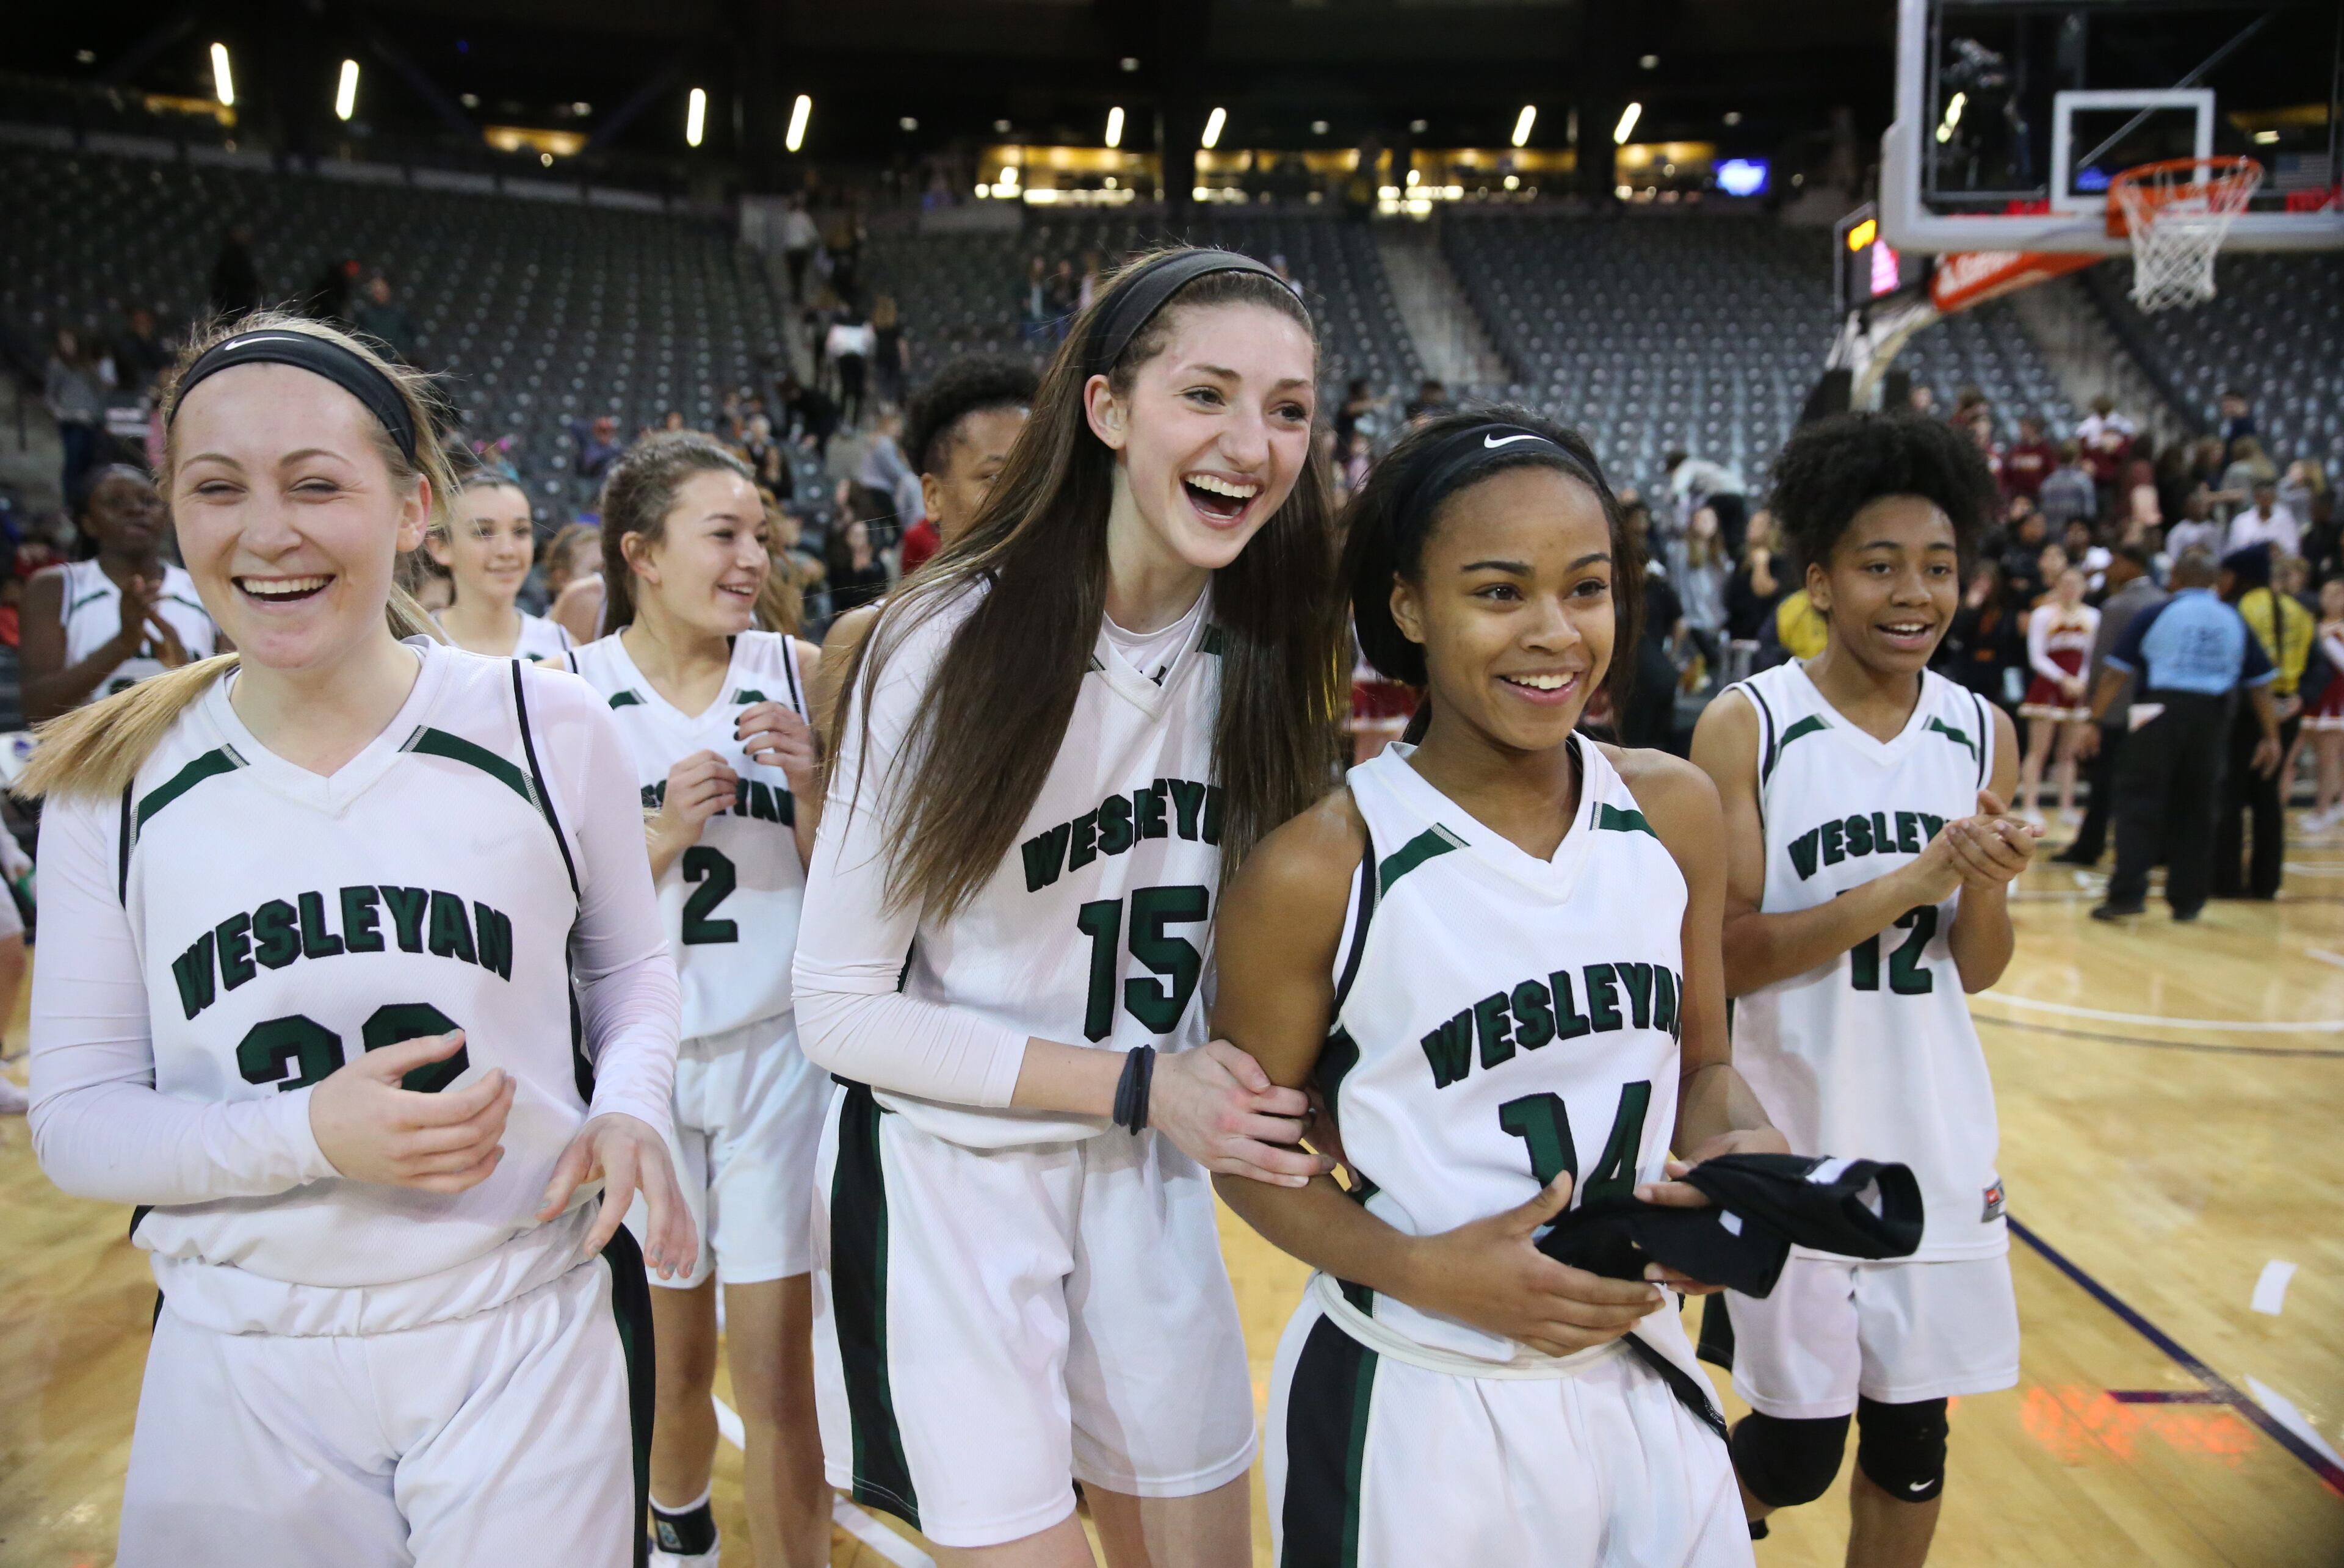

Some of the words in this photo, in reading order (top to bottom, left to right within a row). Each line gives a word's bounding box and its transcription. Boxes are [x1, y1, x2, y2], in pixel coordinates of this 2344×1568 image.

[682, 846, 737, 945] 2
[1788, 811, 1950, 881] WESLEY
[172, 886, 512, 1021] WESLEYAN
[1077, 885, 1209, 1043] 15
[1499, 1080, 1651, 1211] 14
